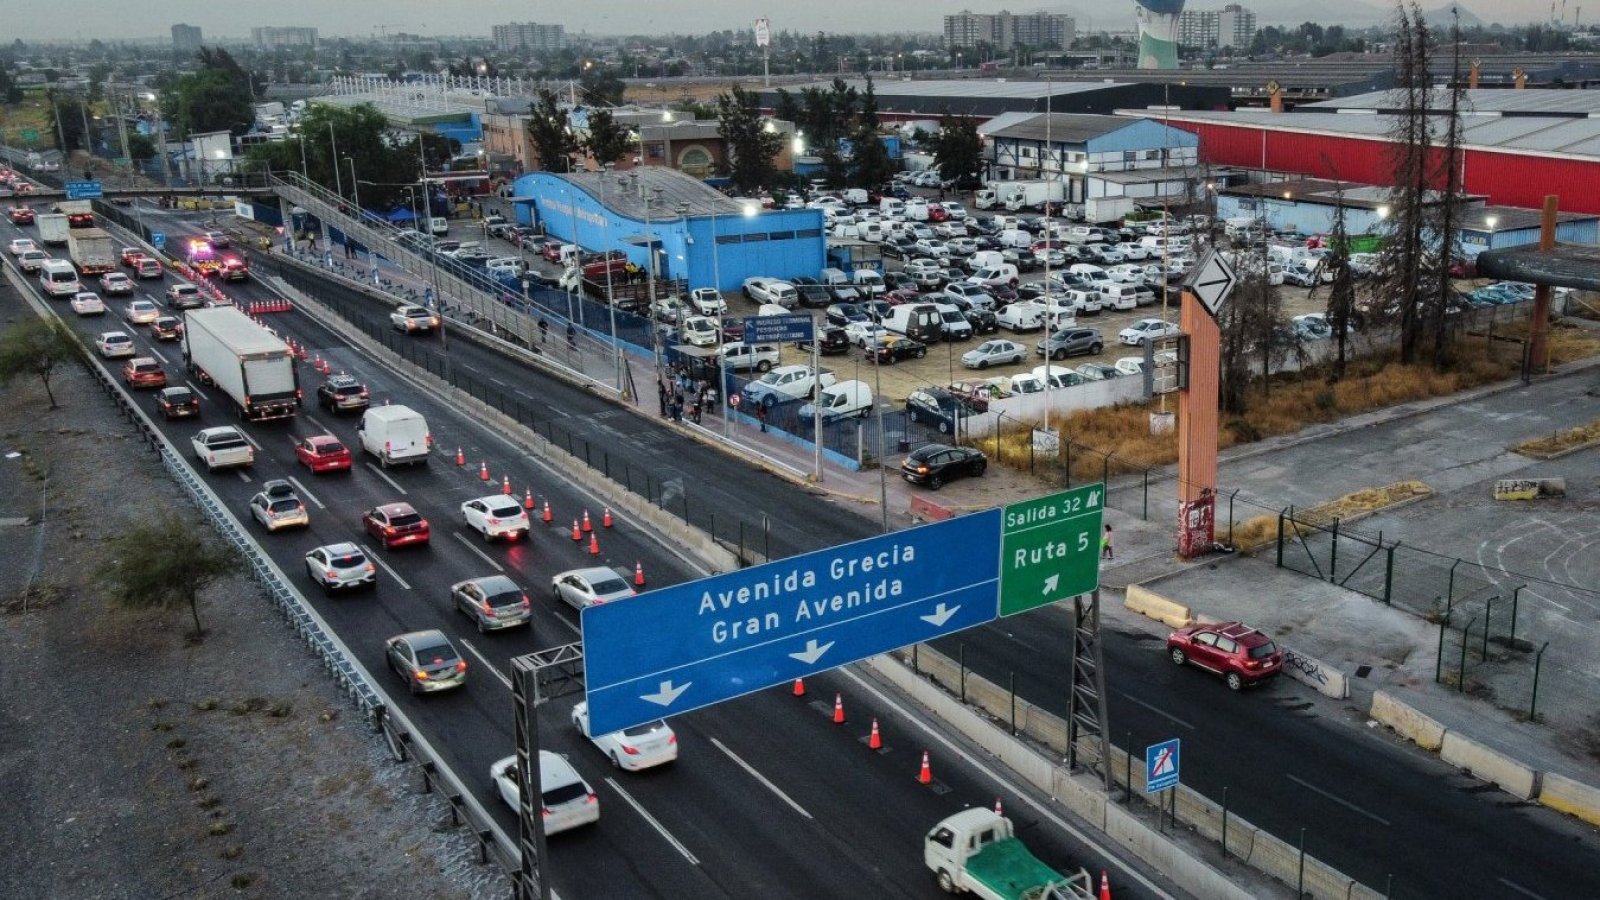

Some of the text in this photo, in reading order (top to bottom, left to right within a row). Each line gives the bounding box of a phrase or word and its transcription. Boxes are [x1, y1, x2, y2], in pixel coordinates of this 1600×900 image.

[1007, 497, 1080, 527] Salida 32
[1015, 532, 1089, 568] Ruta 5
[699, 544, 914, 615] Avenida Grecia
[712, 578, 902, 643] Gran Avenida
